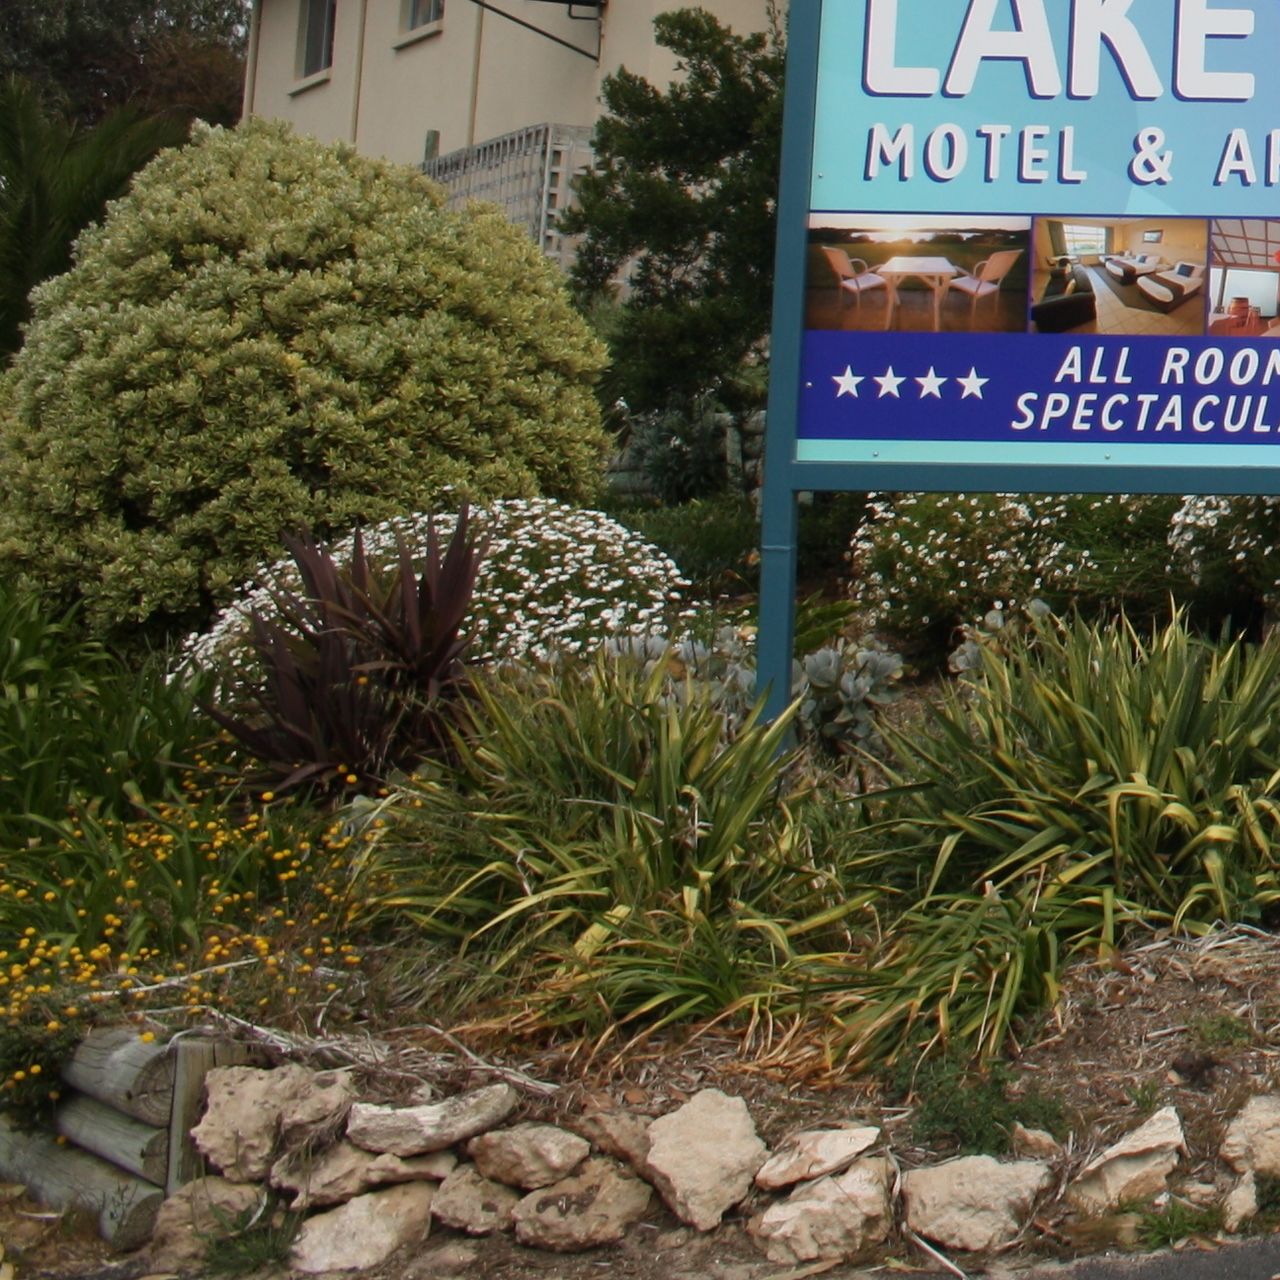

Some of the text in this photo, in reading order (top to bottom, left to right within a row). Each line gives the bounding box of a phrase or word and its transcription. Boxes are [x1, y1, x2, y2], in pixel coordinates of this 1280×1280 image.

[864, 122, 1087, 183] MOTEL
[1129, 126, 1173, 185] &
[1055, 346, 1133, 384] ALL
